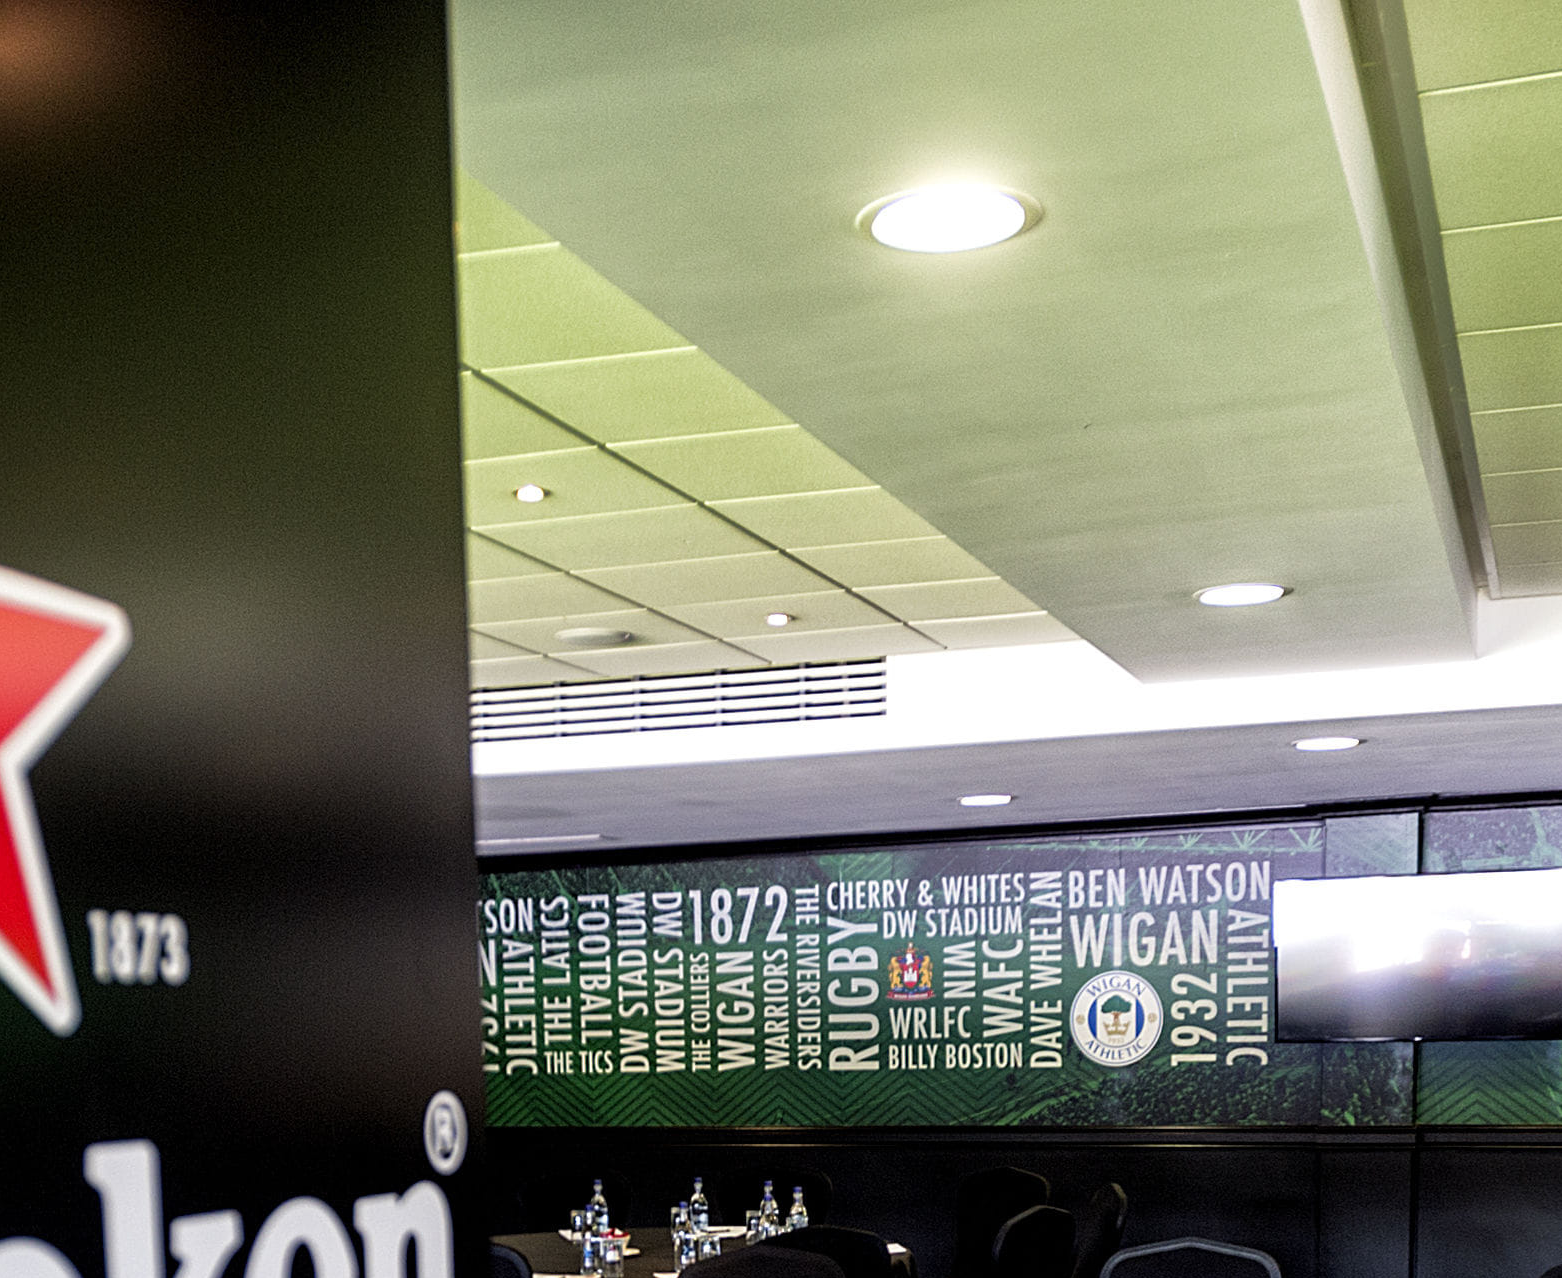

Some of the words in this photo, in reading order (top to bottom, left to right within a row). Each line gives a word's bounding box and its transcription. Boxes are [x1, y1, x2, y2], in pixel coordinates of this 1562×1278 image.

[651, 891, 683, 938] DW
[688, 884, 788, 945] 1872
[794, 883, 820, 926] THE
[826, 878, 909, 911] CHERRY
[917, 879, 934, 907] &
[941, 872, 1026, 906] WHITES
[1068, 867, 1126, 909] BEN
[1138, 860, 1271, 906] WATSON
[479, 897, 534, 935] SON
[539, 895, 571, 985] LATICS
[882, 909, 918, 940] DW
[924, 905, 1023, 938] STADIUM
[1029, 870, 1063, 990] WHELAN
[1069, 908, 1219, 968] WIGAN
[87, 908, 191, 986] 1873
[577, 893, 613, 1045] FOOTBALL
[615, 891, 649, 1018] STADIUM
[942, 940, 976, 999] NIM
[501, 938, 538, 1076] ATHLETIC
[652, 947, 686, 1073] STADIUM
[689, 951, 711, 1033] COLLIERS
[715, 950, 756, 1072] WIGAN
[762, 948, 790, 1070] WARRIORS
[795, 933, 822, 1071] RIVERSIDERS
[826, 915, 880, 1071] RUGBY
[981, 938, 1024, 1038] WAFC
[1087, 976, 1146, 997] WIGAN
[1225, 908, 1270, 1066] ATHLETIC
[542, 995, 573, 1047] THE
[619, 1027, 650, 1073] DW
[888, 1005, 972, 1040] WRLFC
[1029, 999, 1063, 1068] DAVE
[1170, 972, 1218, 1067] 1932
[543, 1051, 574, 1075] THE
[578, 1050, 614, 1074] TICS
[691, 1039, 712, 1073] THE
[888, 1043, 939, 1070] BILLY
[945, 1042, 1023, 1069] BOSTON
[1085, 1040, 1147, 1061] ATHLETIC
